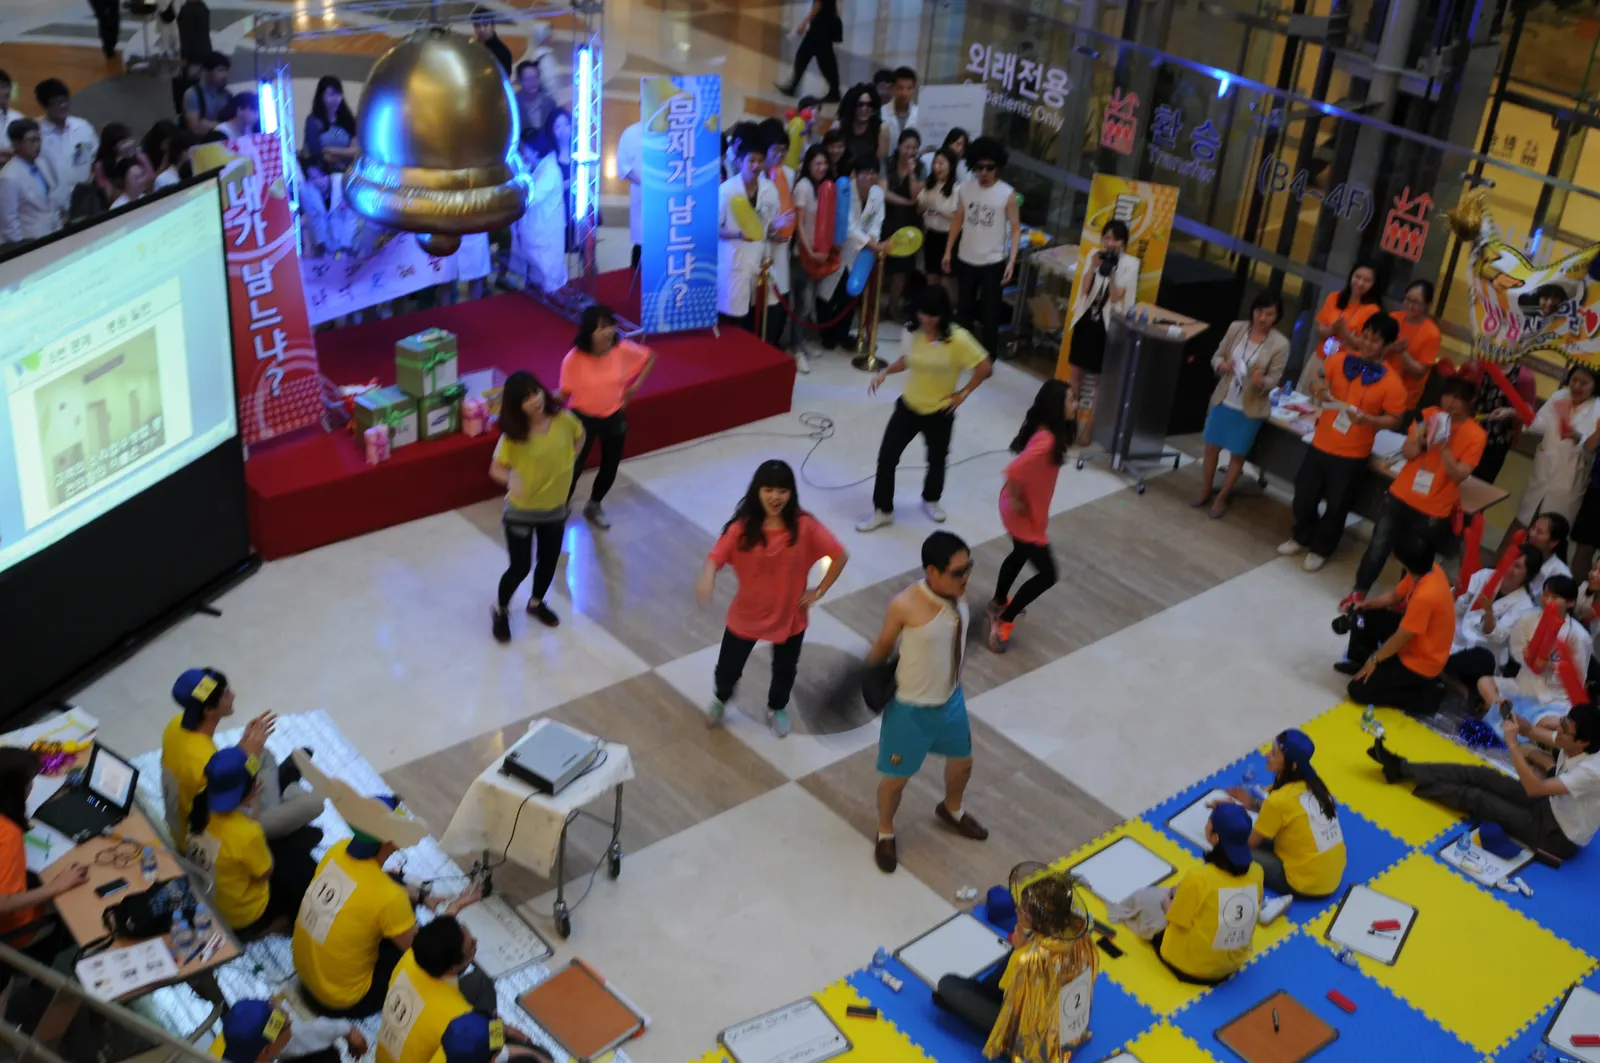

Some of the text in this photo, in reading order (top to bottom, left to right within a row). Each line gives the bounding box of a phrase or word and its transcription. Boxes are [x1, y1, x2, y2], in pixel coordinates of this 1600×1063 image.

[965, 42, 1070, 109] 외래전용
[665, 97, 697, 309] 문제가 남느냐?
[226, 174, 289, 397] 내가 남느냐?
[1234, 904, 1244, 921] 3
[1074, 992, 1082, 1010] 2
